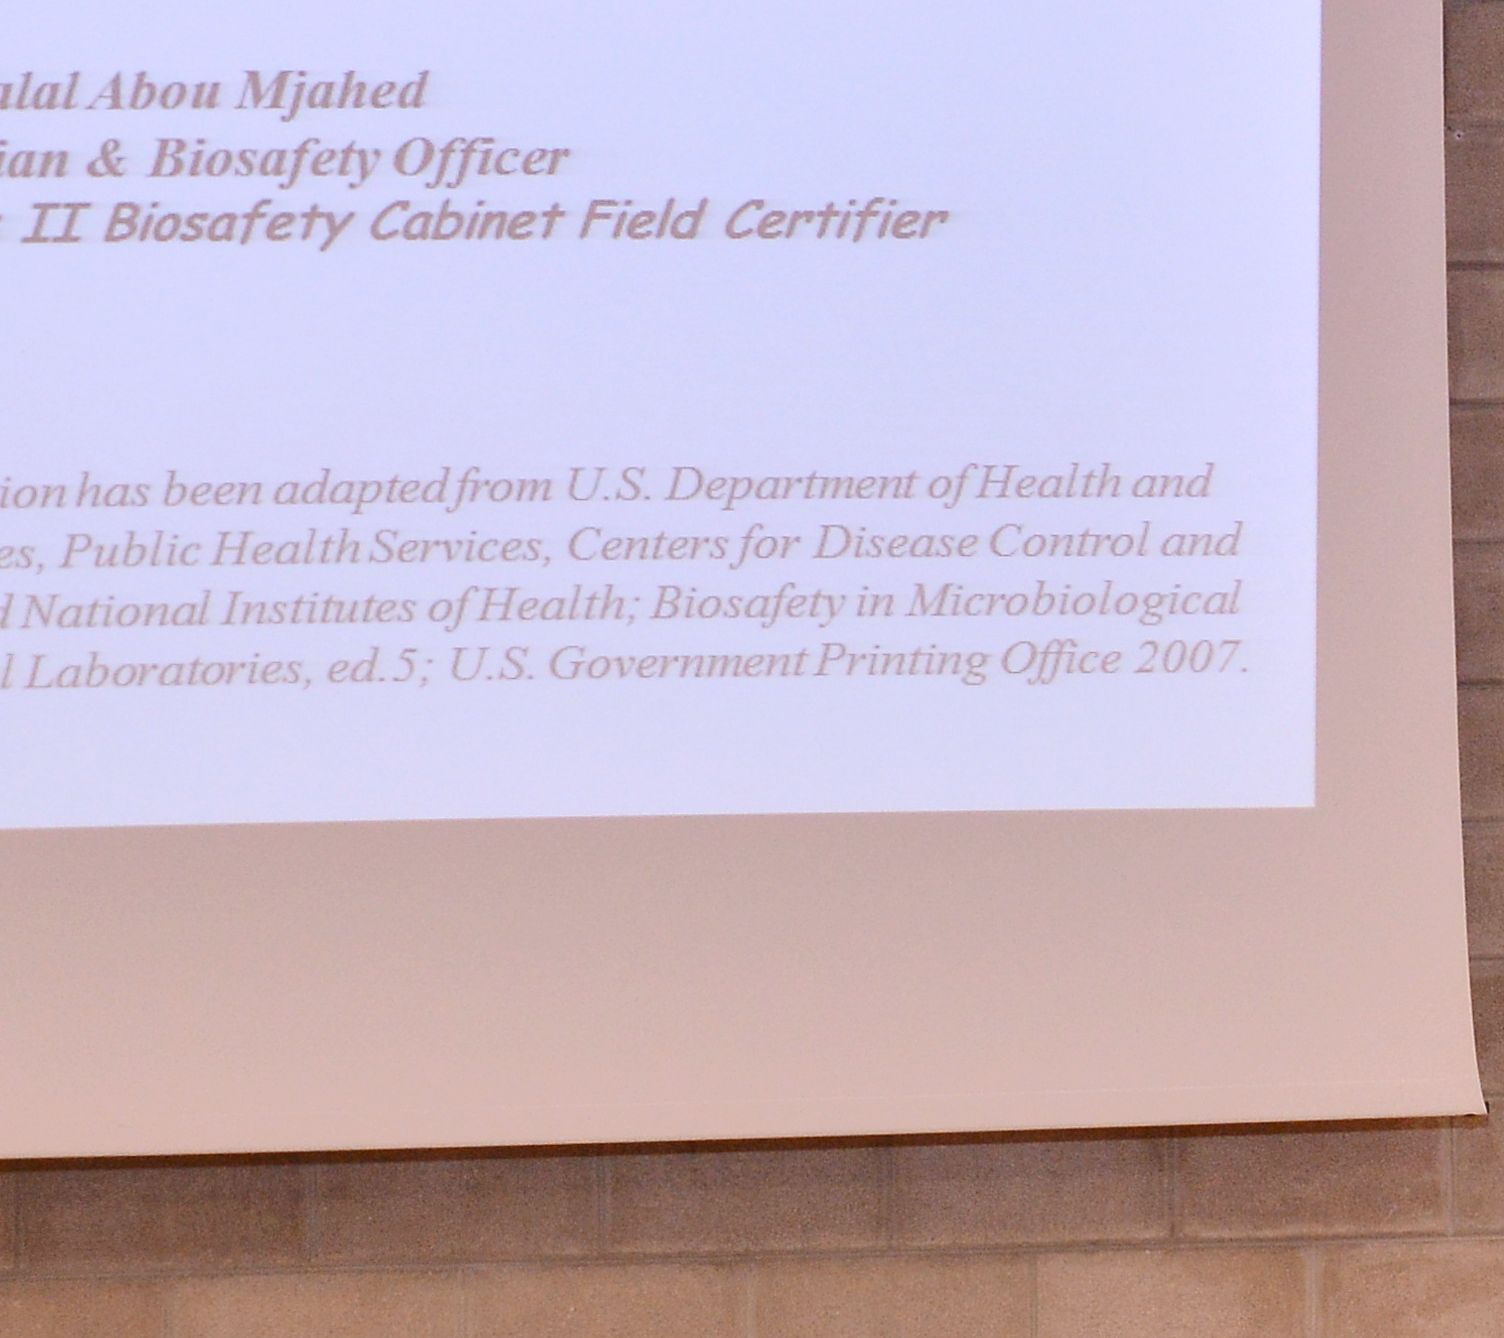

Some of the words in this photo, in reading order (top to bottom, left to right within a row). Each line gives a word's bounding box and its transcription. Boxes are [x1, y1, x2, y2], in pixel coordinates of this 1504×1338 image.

[84, 70, 222, 111] Abou
[234, 69, 430, 123] Mjahed
[85, 138, 126, 178] &
[147, 137, 383, 191] Biosafety
[392, 136, 572, 190] Officer
[20, 201, 90, 244] II
[103, 197, 355, 253] Biosafety
[369, 197, 567, 241] Cabinet
[578, 197, 707, 240] Field
[724, 196, 951, 244] Certifier
[74, 470, 151, 508] has
[162, 469, 263, 507] been
[272, 465, 447, 516] adapted
[446, 465, 553, 514] from
[567, 466, 652, 502] U.S.
[664, 465, 919, 512] Department
[926, 462, 980, 510] of
[978, 461, 1122, 499] Health
[1130, 461, 1216, 499] and
[58, 529, 202, 569] Public
[210, 526, 361, 567] Health
[367, 528, 552, 567] Services,
[567, 526, 726, 562] Centers
[728, 522, 802, 571] for
[812, 523, 980, 559] Disease
[988, 520, 1151, 558] Control
[1159, 519, 1244, 557] and
[19, 588, 212, 630] National
[220, 590, 418, 626] Institutes
[426, 584, 477, 634] of
[476, 583, 641, 625] Health;
[649, 581, 848, 630] Biosafety
[855, 585, 895, 618] in
[904, 578, 1243, 627] Microbiological
[23, 650, 312, 690] Laboratories,
[450, 645, 535, 682] U.S.
[548, 644, 810, 681] Government
[812, 641, 992, 687] Printing
[1000, 637, 1123, 686] Office
[1133, 638, 1248, 675] 2007.
